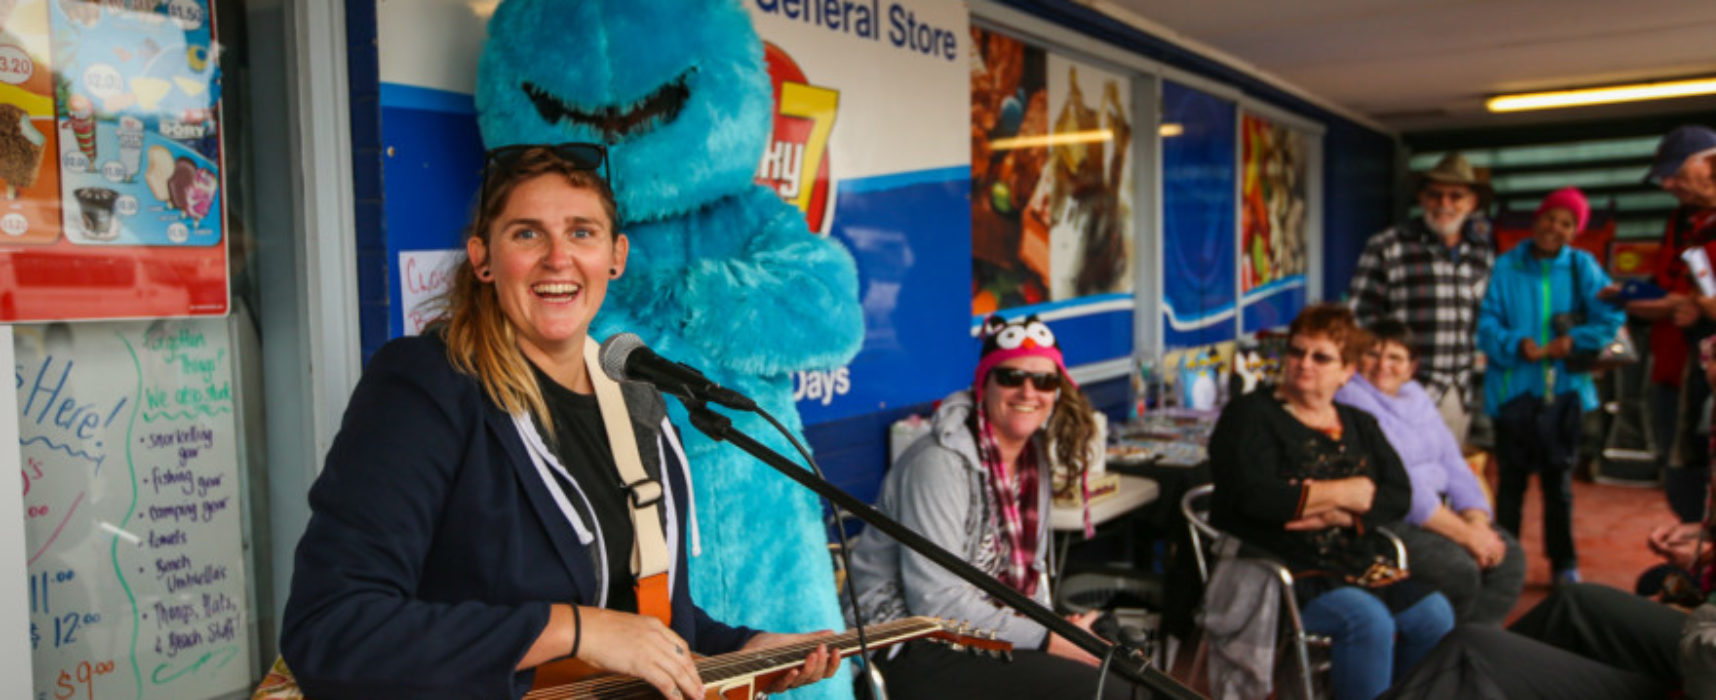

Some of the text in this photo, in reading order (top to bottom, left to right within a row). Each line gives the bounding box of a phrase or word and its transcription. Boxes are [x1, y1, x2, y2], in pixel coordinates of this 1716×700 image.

[889, 3, 956, 60] Store
[780, 80, 839, 213] 7
[24, 356, 127, 447] Here!
[151, 465, 195, 496] fishing
